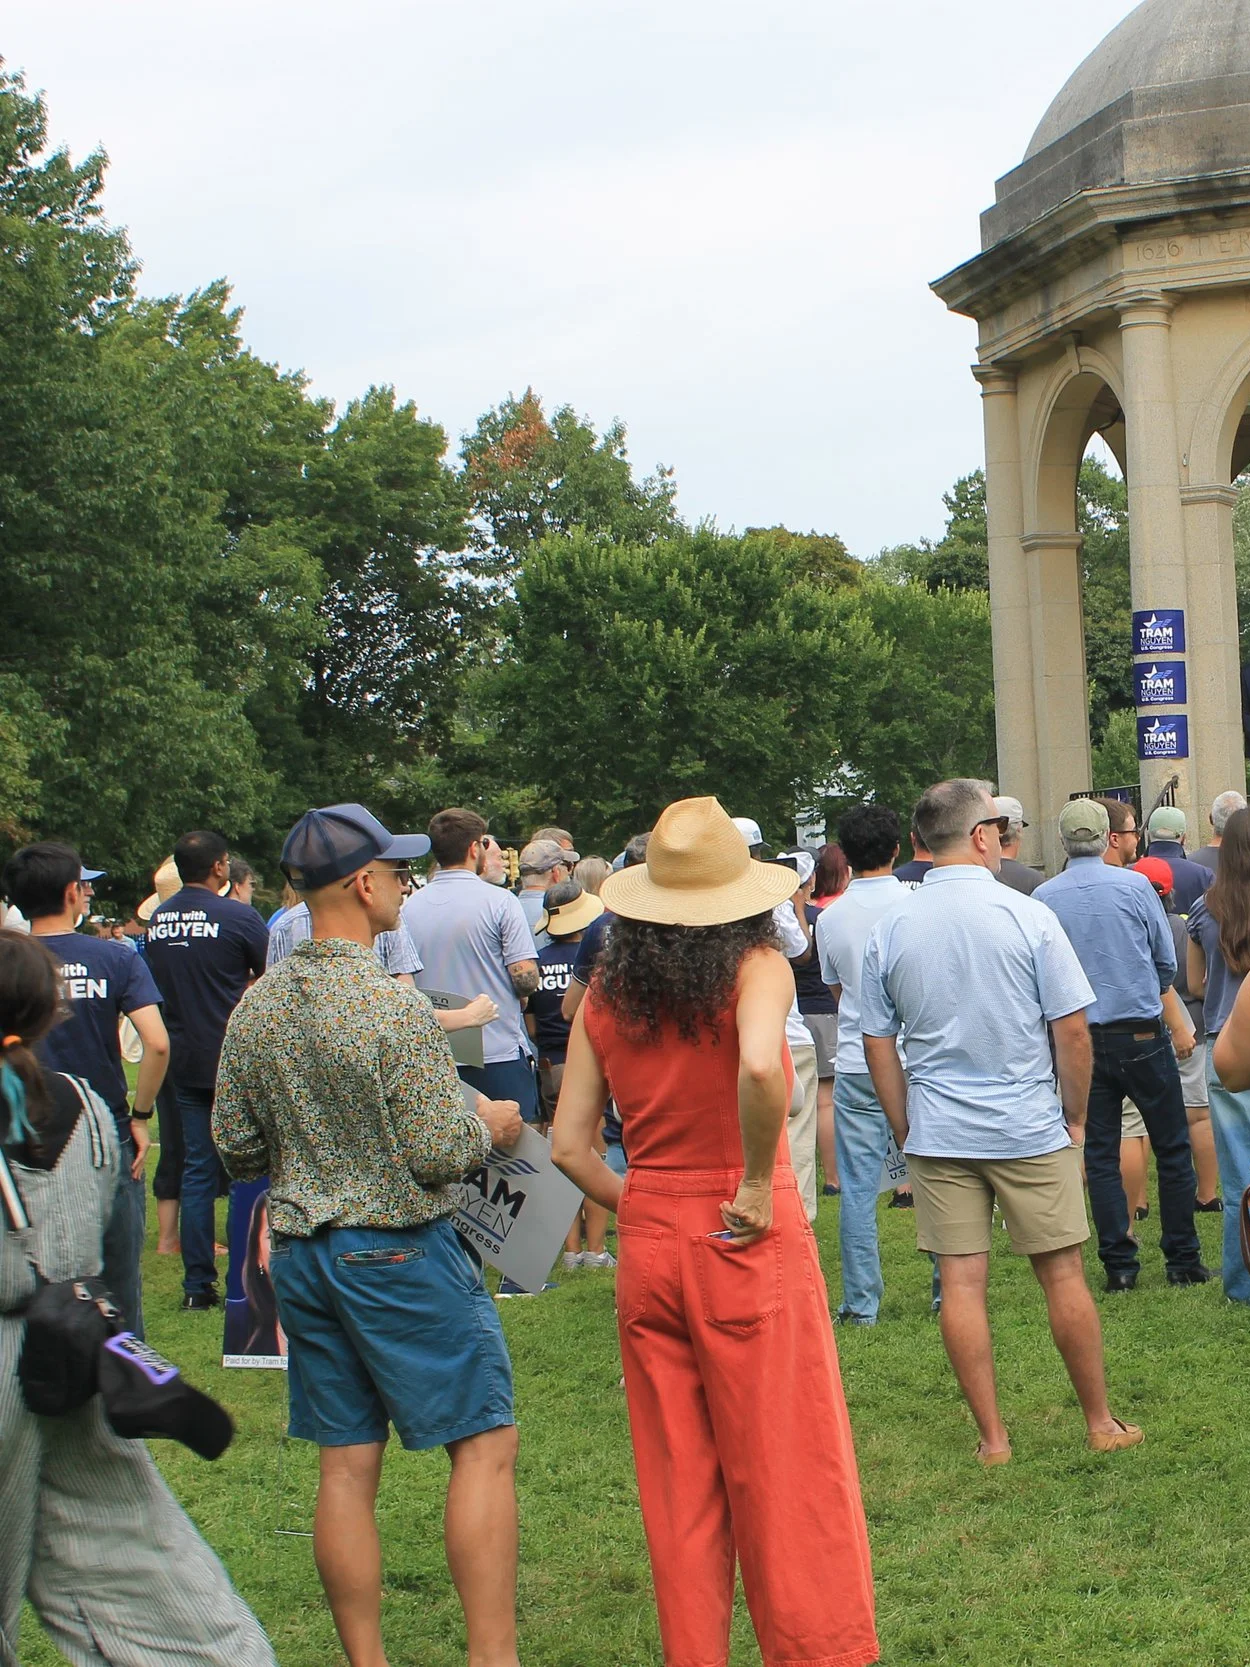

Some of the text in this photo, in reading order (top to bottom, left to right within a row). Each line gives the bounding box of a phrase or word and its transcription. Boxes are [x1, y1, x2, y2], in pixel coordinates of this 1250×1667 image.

[1136, 239, 1181, 262] 1626
[1140, 627, 1172, 638] TRAM
[1140, 637, 1172, 645] NGUYEN
[1141, 678, 1173, 689] TRAM
[1141, 688, 1173, 696] NGUYEN
[1144, 732, 1176, 742] TRAM
[1144, 741, 1176, 750] NGUYEN
[157, 911, 207, 922] WIN with
[148, 922, 219, 942] NGUYEN
[542, 964, 568, 974] WIN
[890, 1169, 909, 1180] U.S.
[462, 1167, 526, 1219] AM
[466, 1188, 514, 1238] YEN
[451, 1215, 500, 1254] ngress
